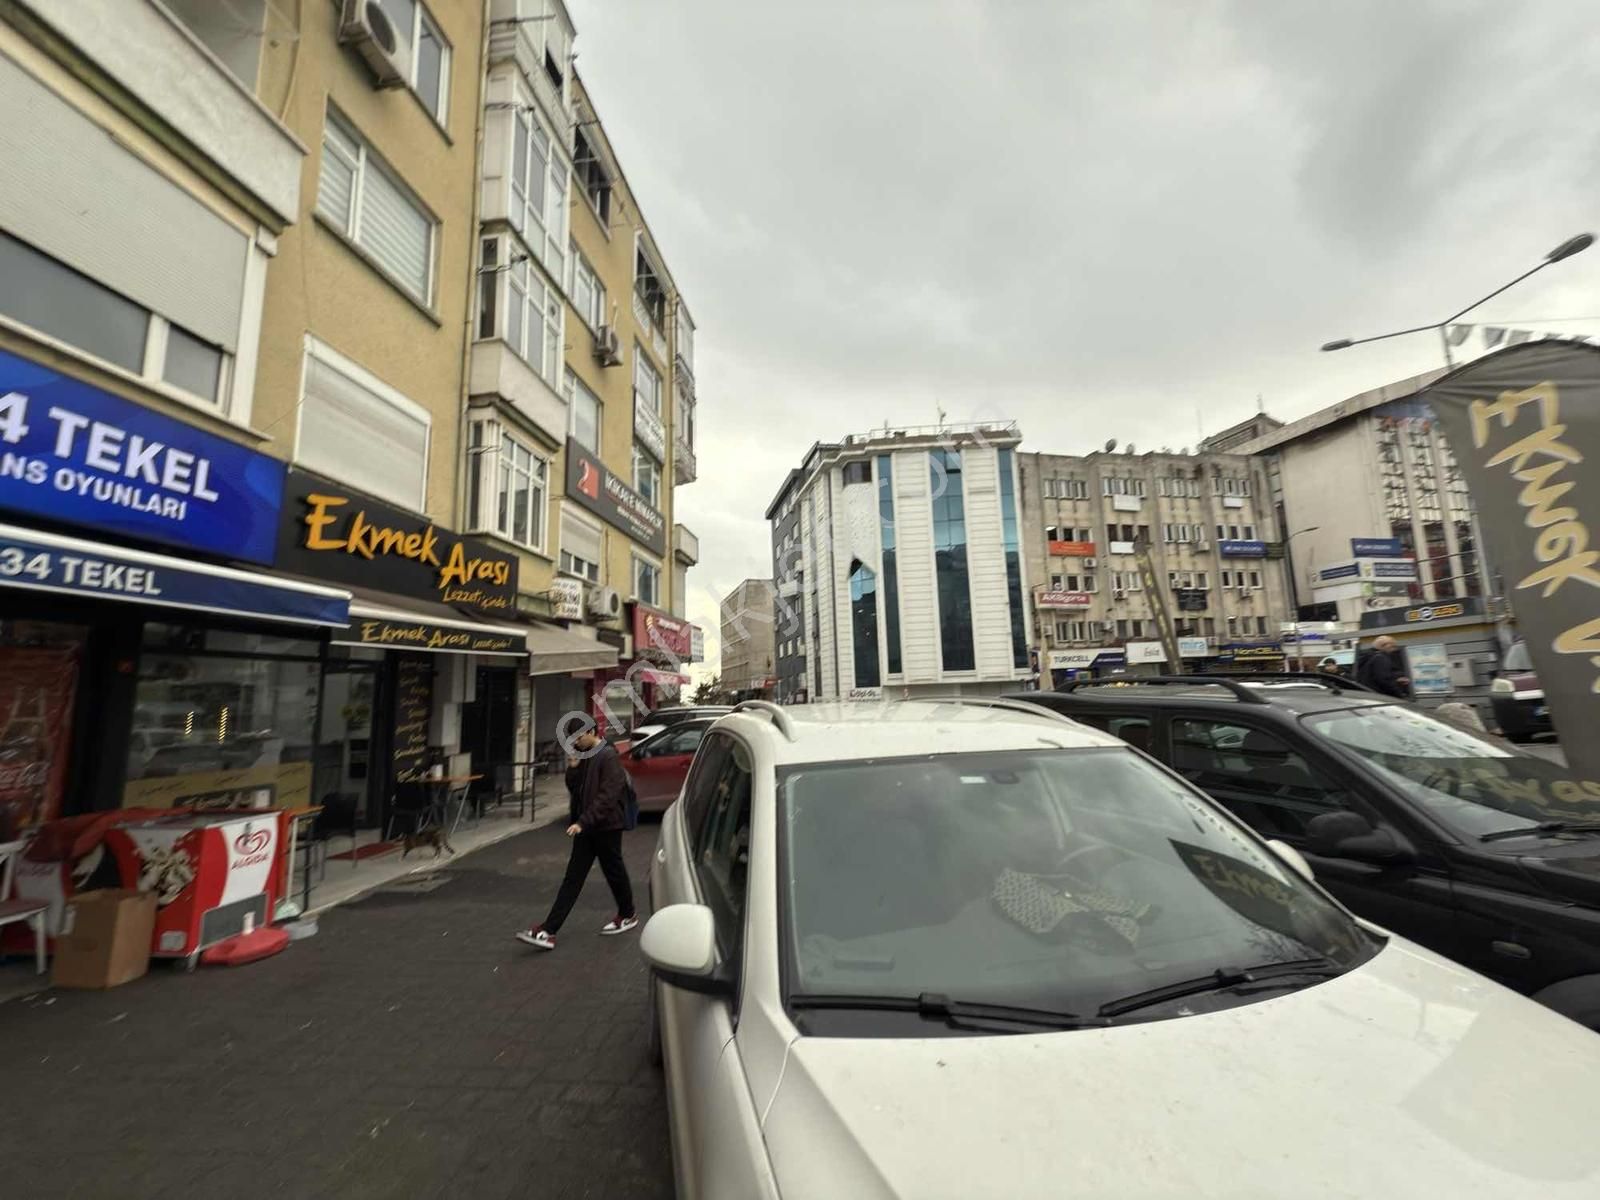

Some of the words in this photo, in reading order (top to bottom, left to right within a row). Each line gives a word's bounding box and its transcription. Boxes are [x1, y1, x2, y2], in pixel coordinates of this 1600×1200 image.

[49, 406, 219, 503] TEKEL
[54, 468, 187, 521] OYUNLARI
[305, 493, 440, 567] Ekmek
[0, 547, 53, 580] 34
[59, 556, 162, 596] TEKEL
[360, 621, 428, 642] Ekmek
